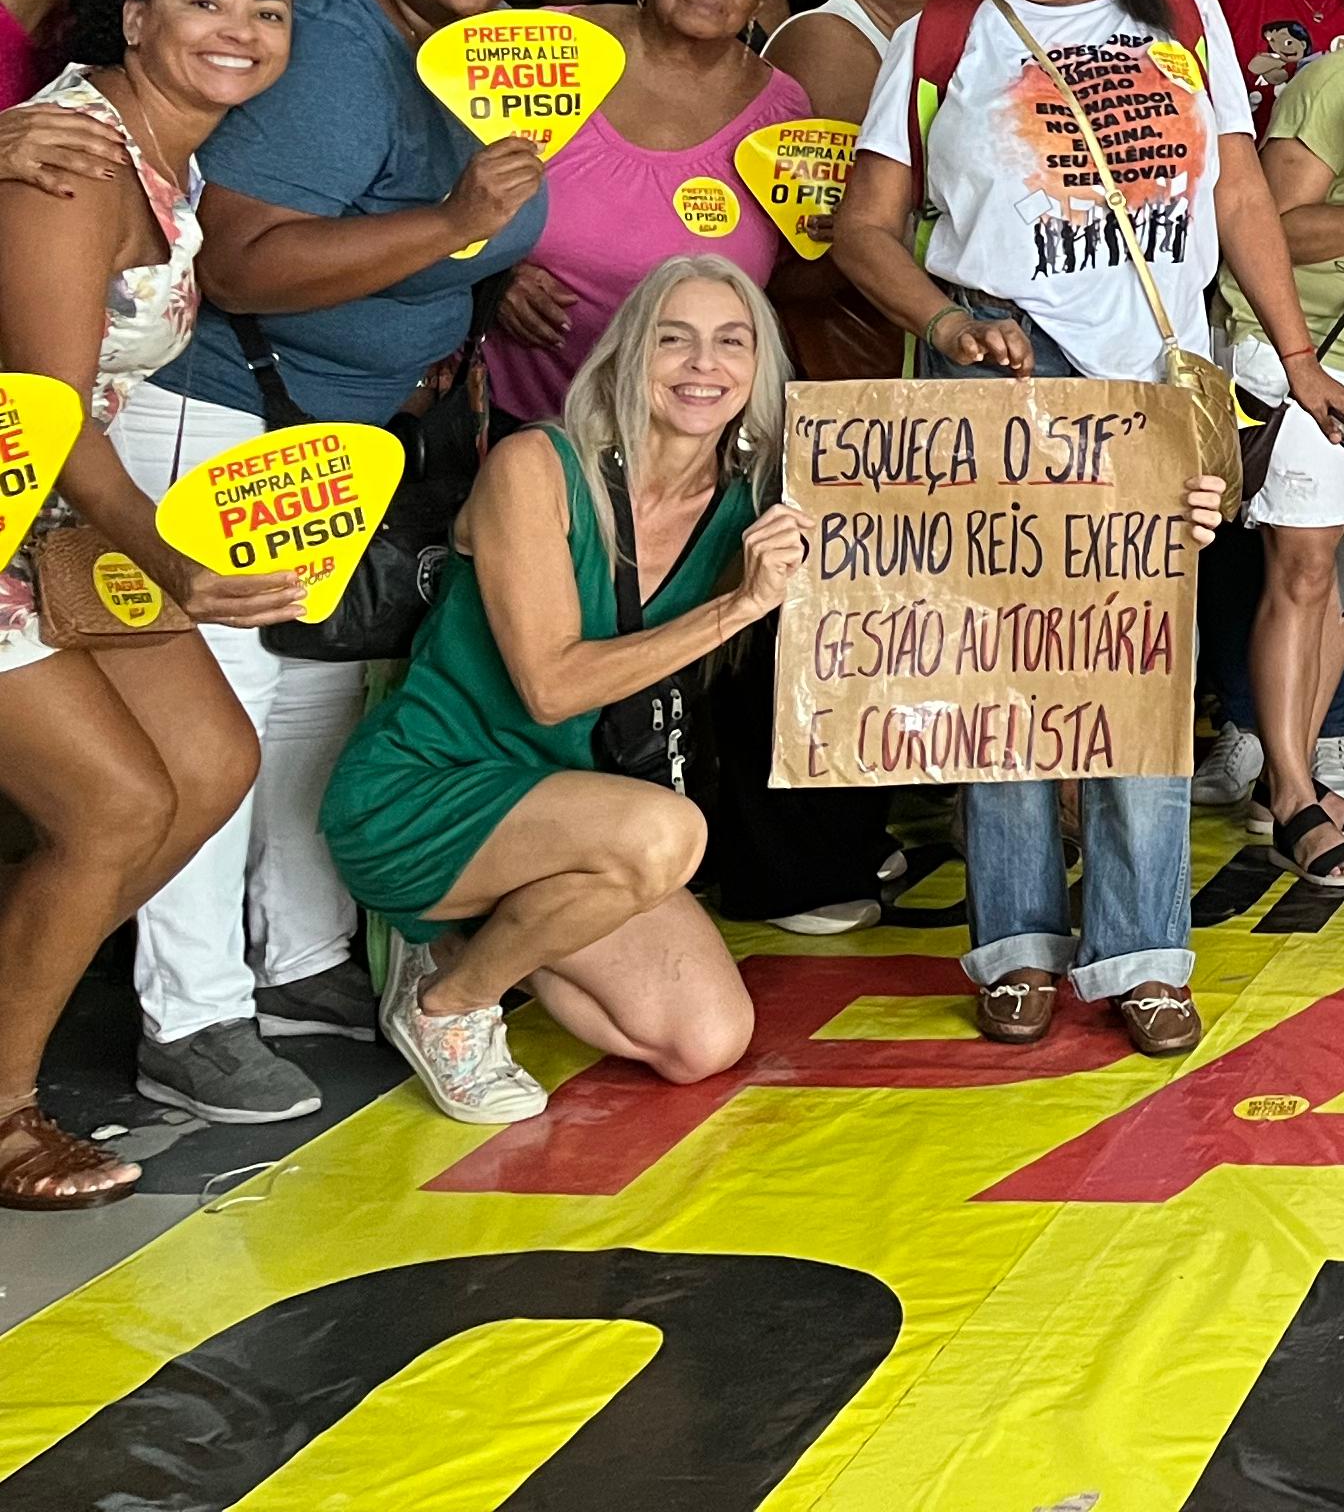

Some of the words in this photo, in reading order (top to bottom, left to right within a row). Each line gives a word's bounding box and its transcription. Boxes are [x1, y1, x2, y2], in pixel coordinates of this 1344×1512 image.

[464, 27, 578, 44] PREFEITO,
[466, 47, 532, 62] CUMPRA
[536, 48, 547, 61] A
[468, 64, 580, 90] PAGUE
[471, 98, 491, 120] O
[502, 94, 581, 118] PISO!
[1125, 103, 1179, 123] LUTA
[1046, 154, 1088, 168] SEU
[208, 434, 347, 487] PREFEITO,
[1004, 416, 1033, 482] O
[213, 470, 295, 508] CUMPRA
[300, 465, 314, 484] A
[318, 453, 352, 481] LEI!
[219, 473, 359, 540] PAGUE
[228, 540, 256, 568] O
[264, 505, 366, 561] PISO!
[820, 509, 953, 581] BRUNO
[966, 501, 1042, 579] REIS
[1064, 509, 1187, 580] EXERCE
[812, 596, 943, 680] GESTÃO
[954, 589, 1174, 678] AUTORITÁRIA
[807, 705, 837, 777] E
[857, 695, 1114, 774] CORONELISTA
